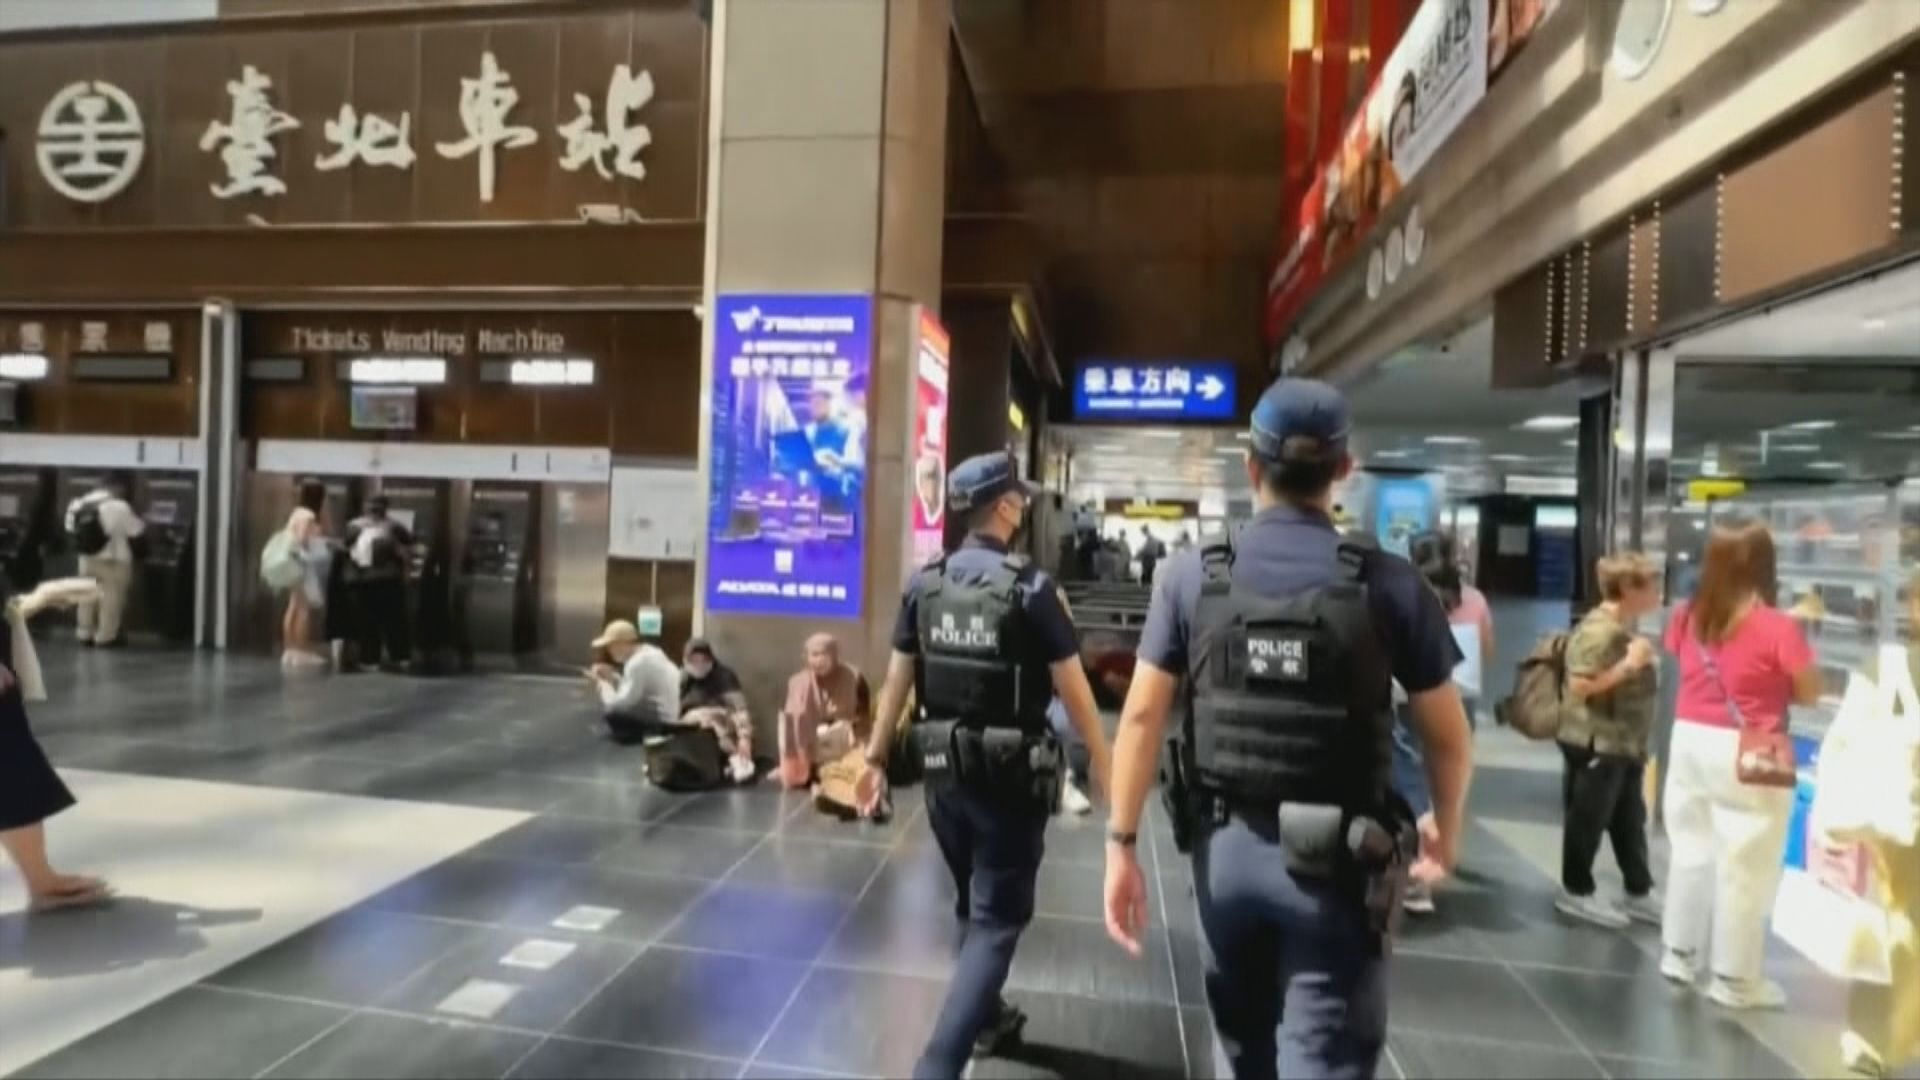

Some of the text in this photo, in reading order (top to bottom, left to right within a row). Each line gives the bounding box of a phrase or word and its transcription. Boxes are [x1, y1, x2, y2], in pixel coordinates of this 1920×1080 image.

[199, 51, 655, 202] 臺北車站
[291, 327, 565, 354] Tickets Vending Machine
[930, 626, 998, 648] POLICE
[1247, 638, 1303, 658] POLICE
